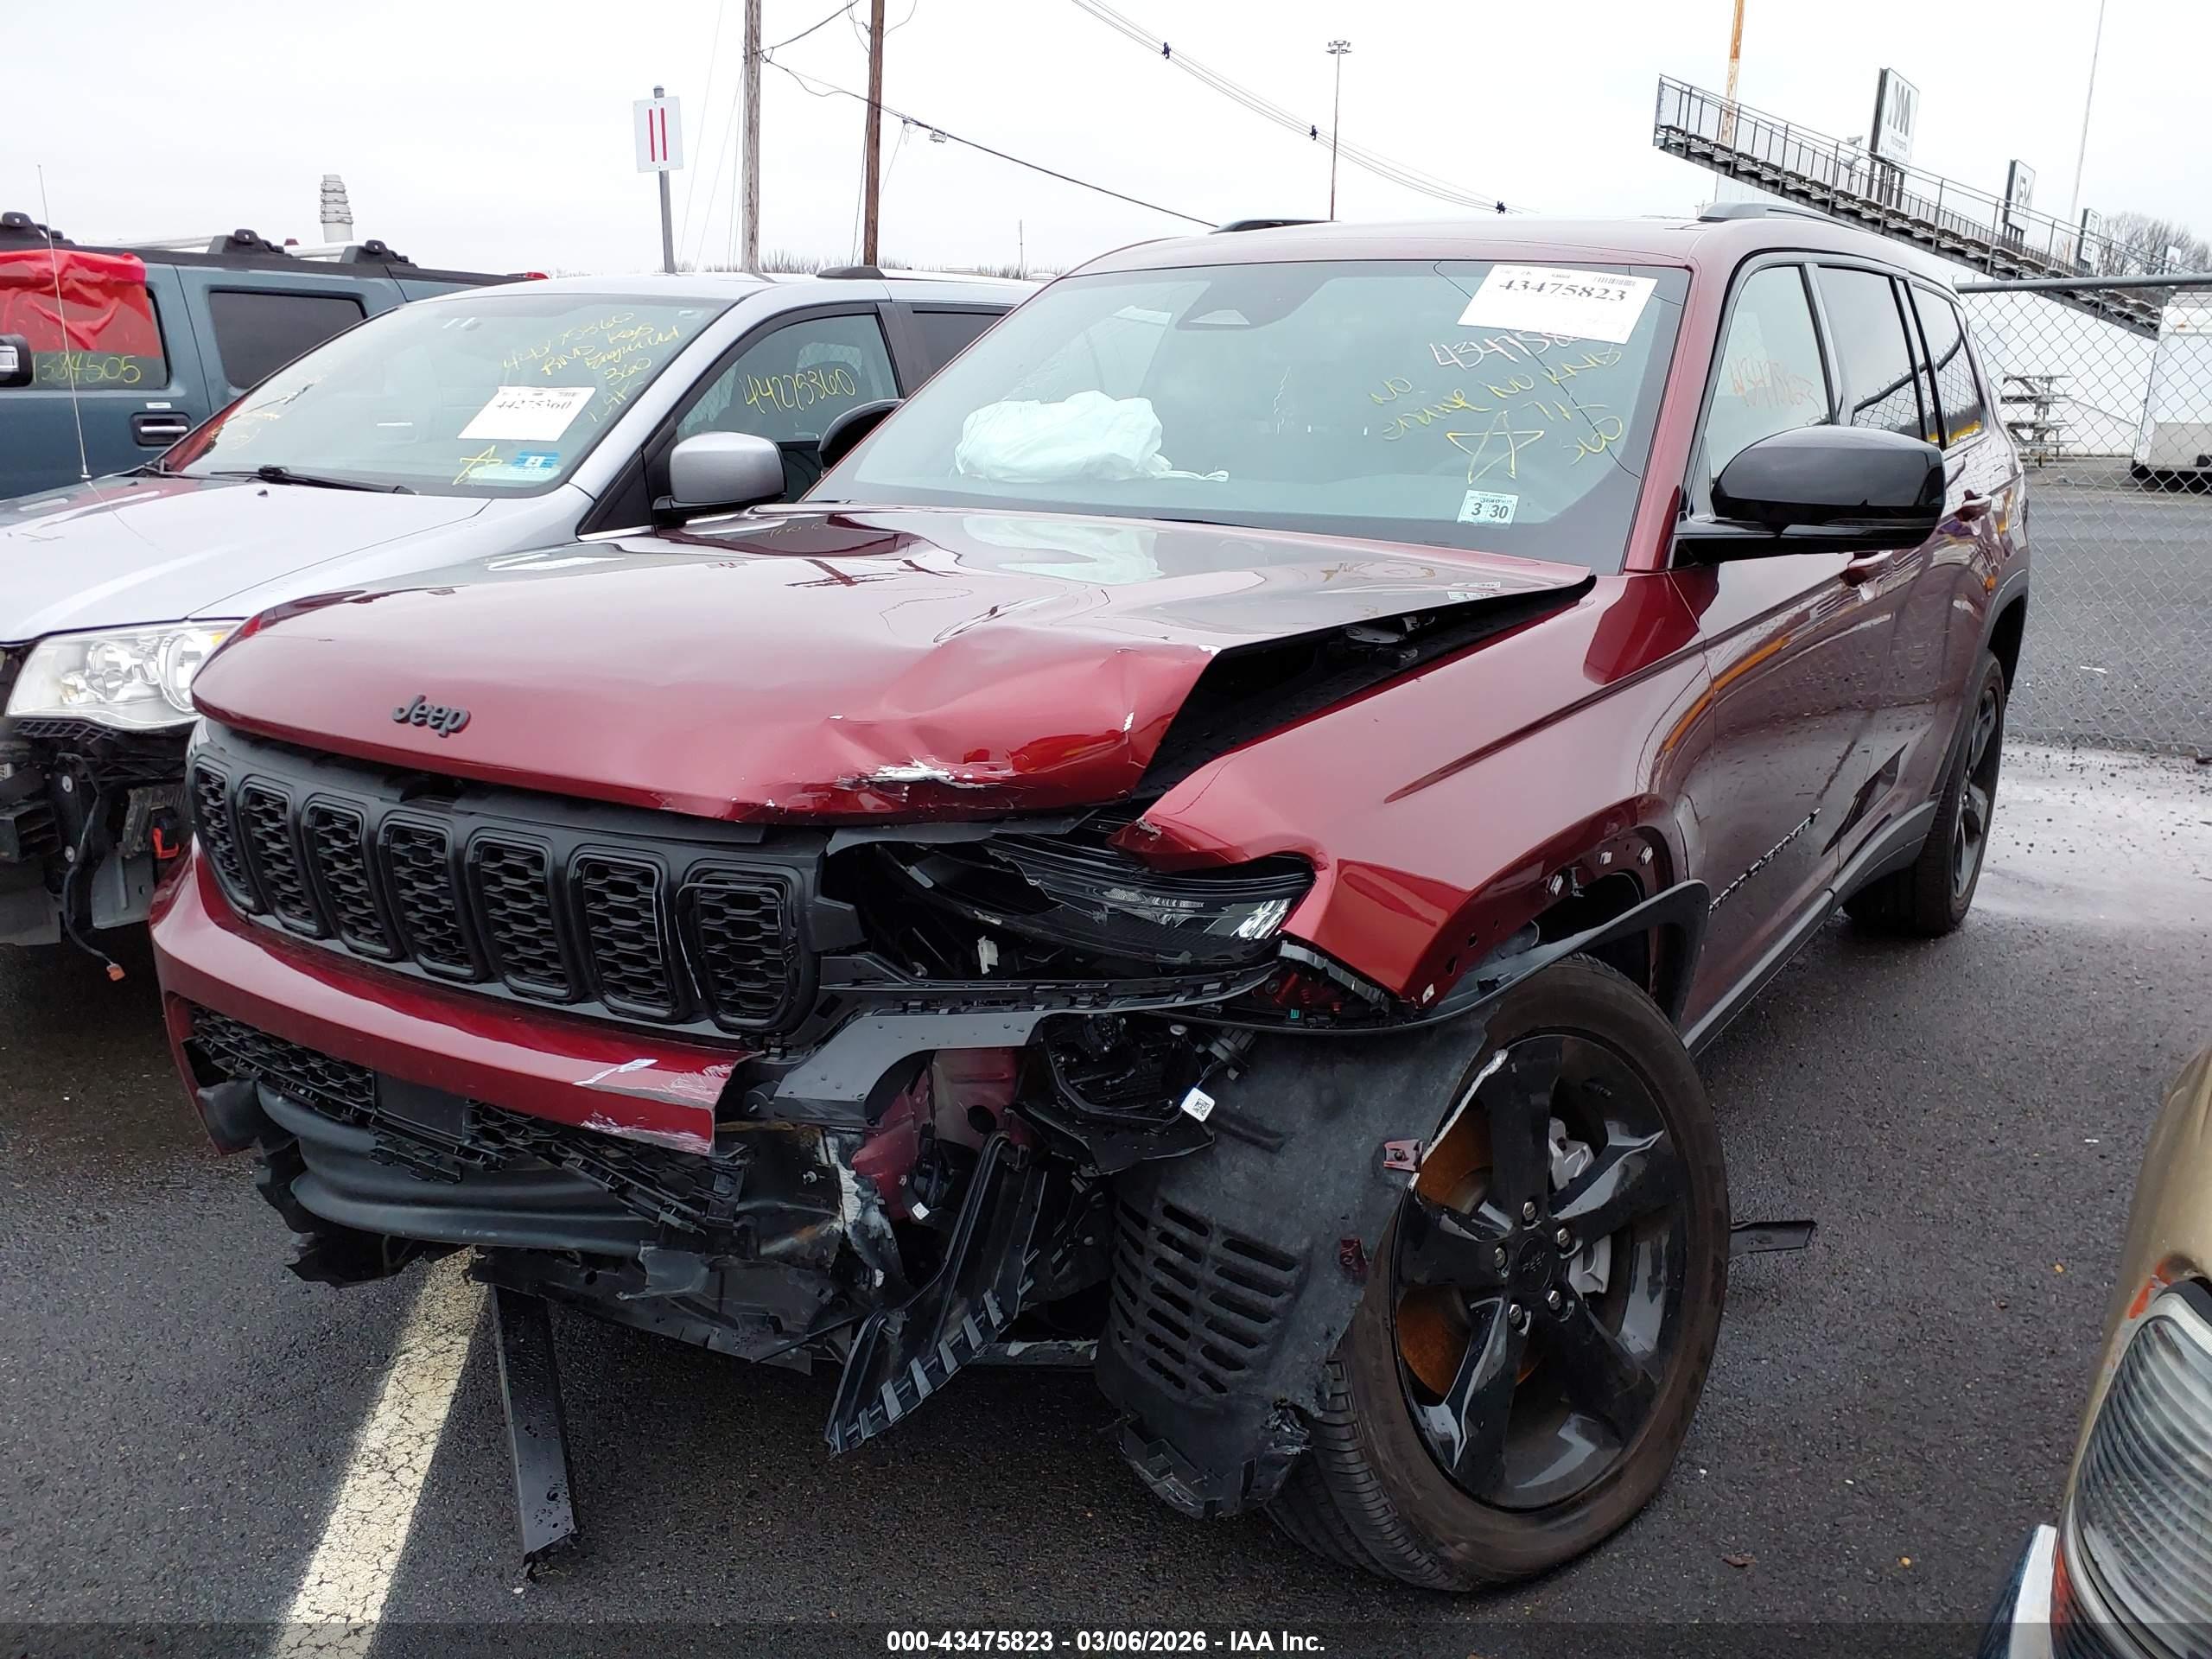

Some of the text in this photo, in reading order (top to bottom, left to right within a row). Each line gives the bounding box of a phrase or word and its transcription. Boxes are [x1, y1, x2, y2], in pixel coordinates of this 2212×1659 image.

[1499, 279, 1627, 302] 43475823
[1428, 329, 1583, 371] 43475
[1471, 502, 1509, 519] 3 30
[391, 694, 472, 739] Jeep
